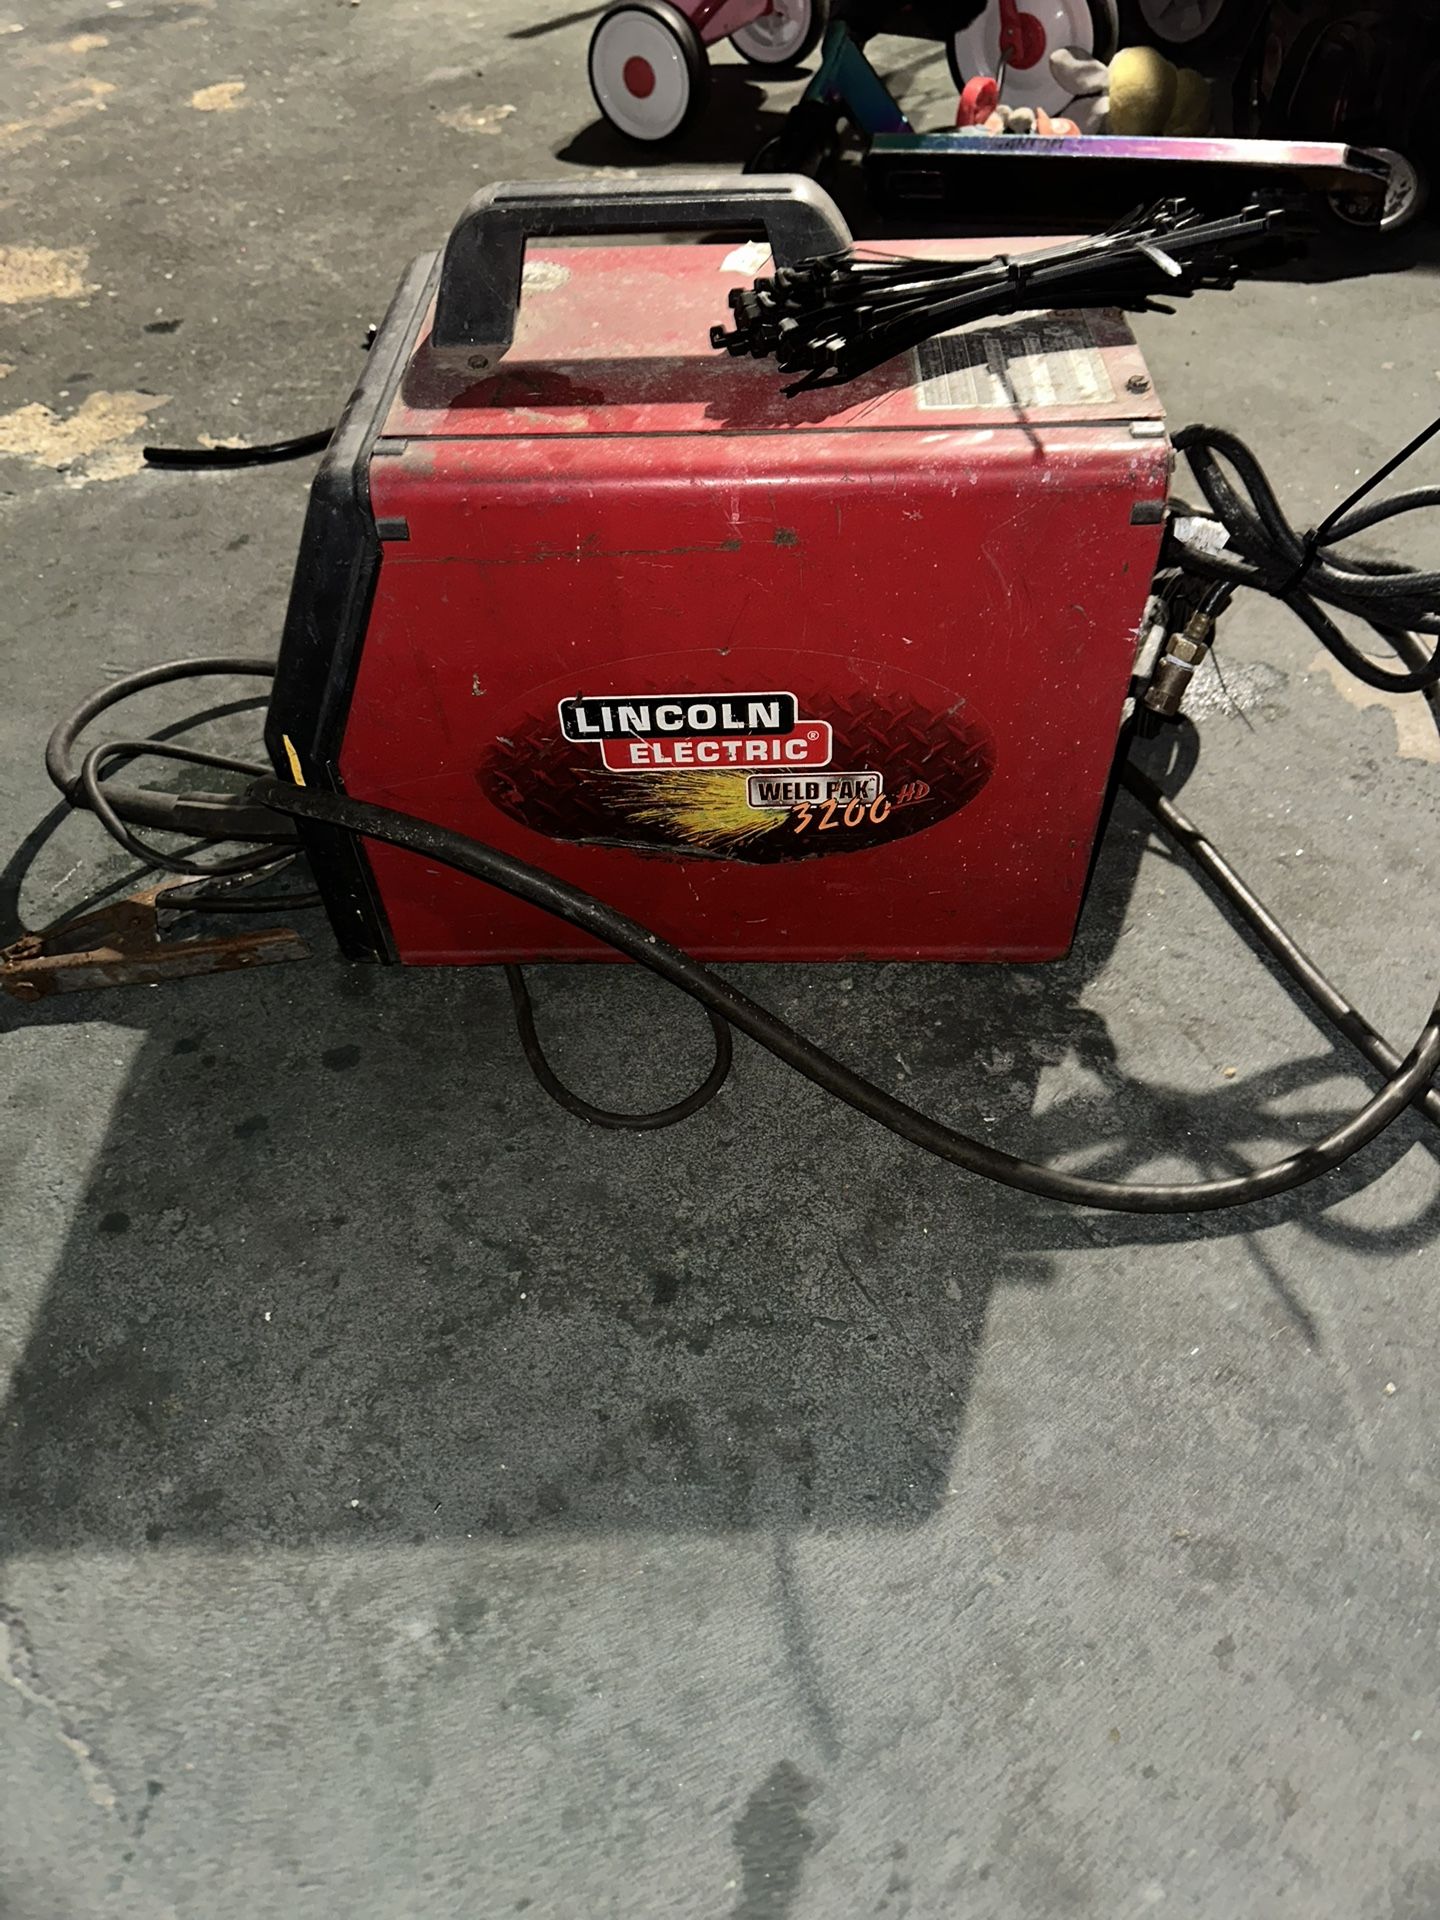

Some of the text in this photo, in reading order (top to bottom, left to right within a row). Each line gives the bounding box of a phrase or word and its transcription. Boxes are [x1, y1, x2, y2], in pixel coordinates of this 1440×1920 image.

[575, 702, 780, 733] LINCOLN
[758, 779, 869, 801] WELD PAK
[792, 780, 931, 834] 3200 HD
